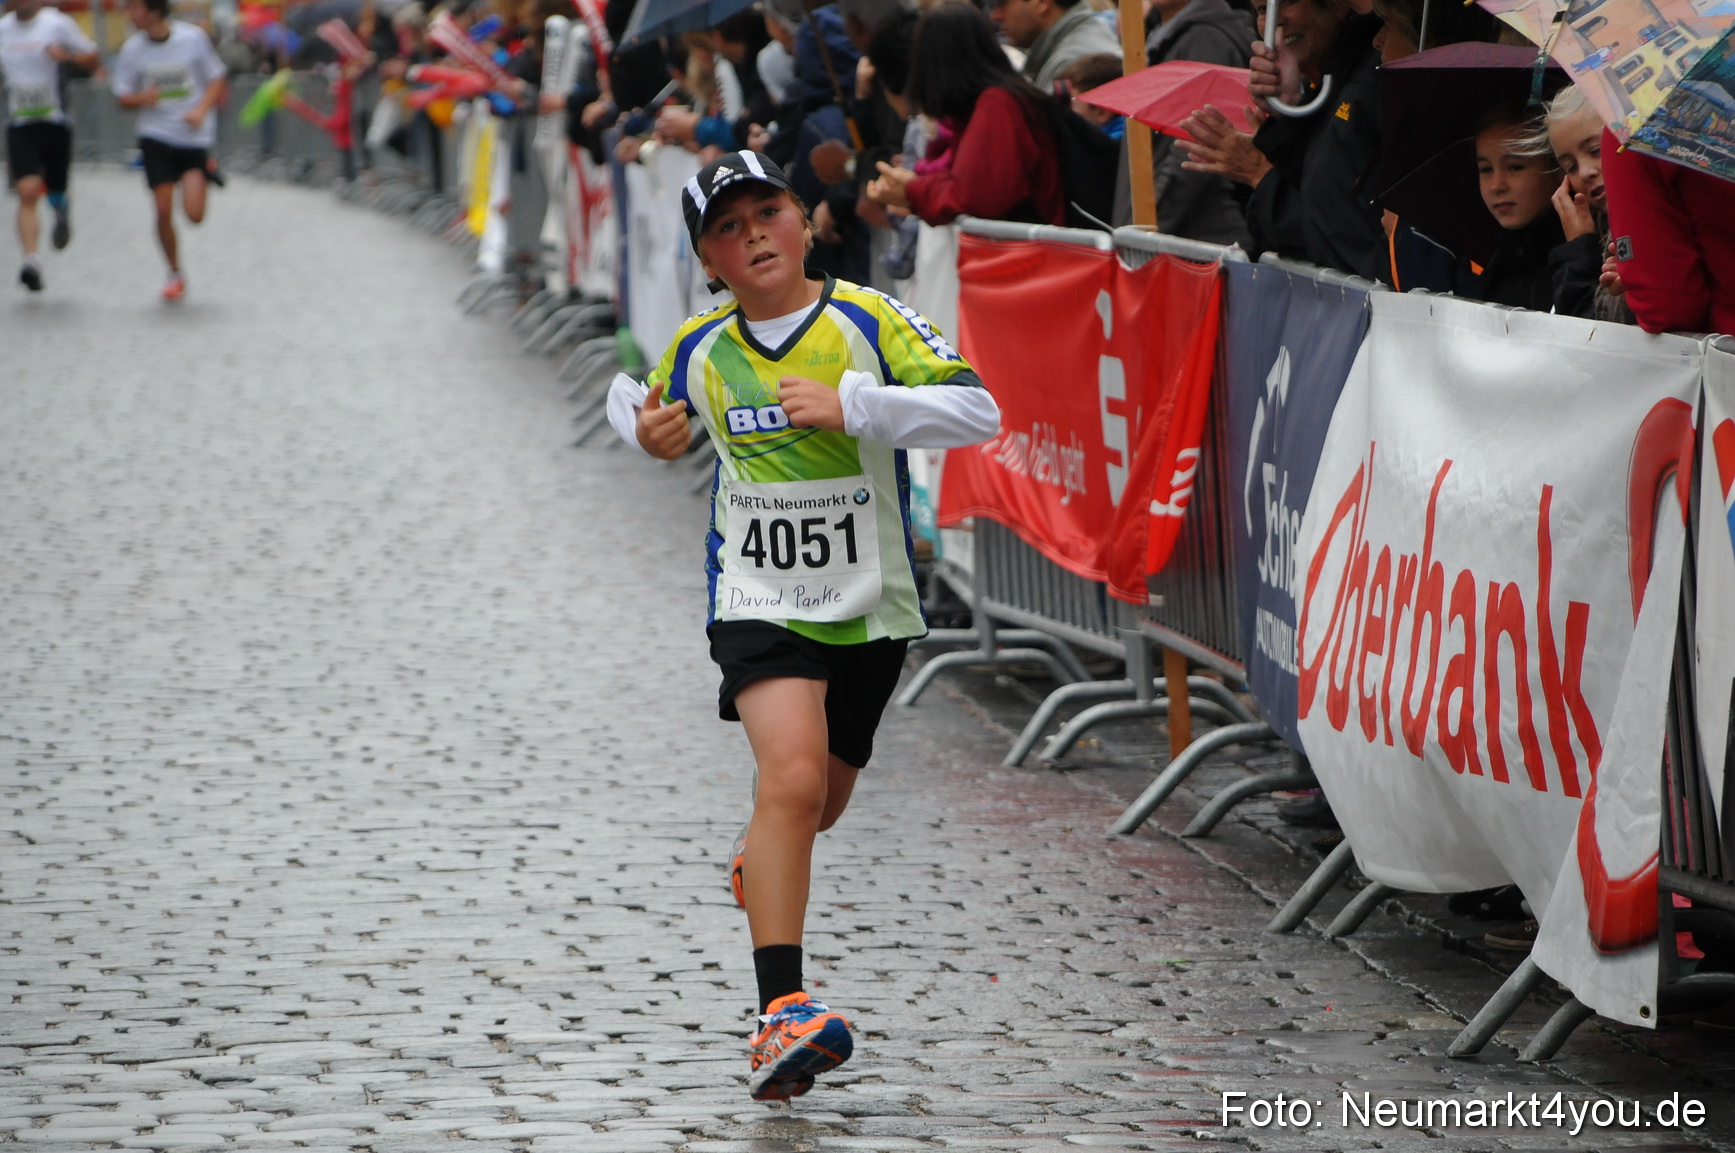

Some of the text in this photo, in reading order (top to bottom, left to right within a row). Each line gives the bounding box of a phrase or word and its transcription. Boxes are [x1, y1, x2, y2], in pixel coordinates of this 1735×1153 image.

[725, 404, 790, 435] BO
[730, 494, 847, 510] PARTL Neumarkt
[740, 512, 858, 570] 4051
[729, 586, 783, 610] David
[1298, 441, 1602, 799] Oberbank
